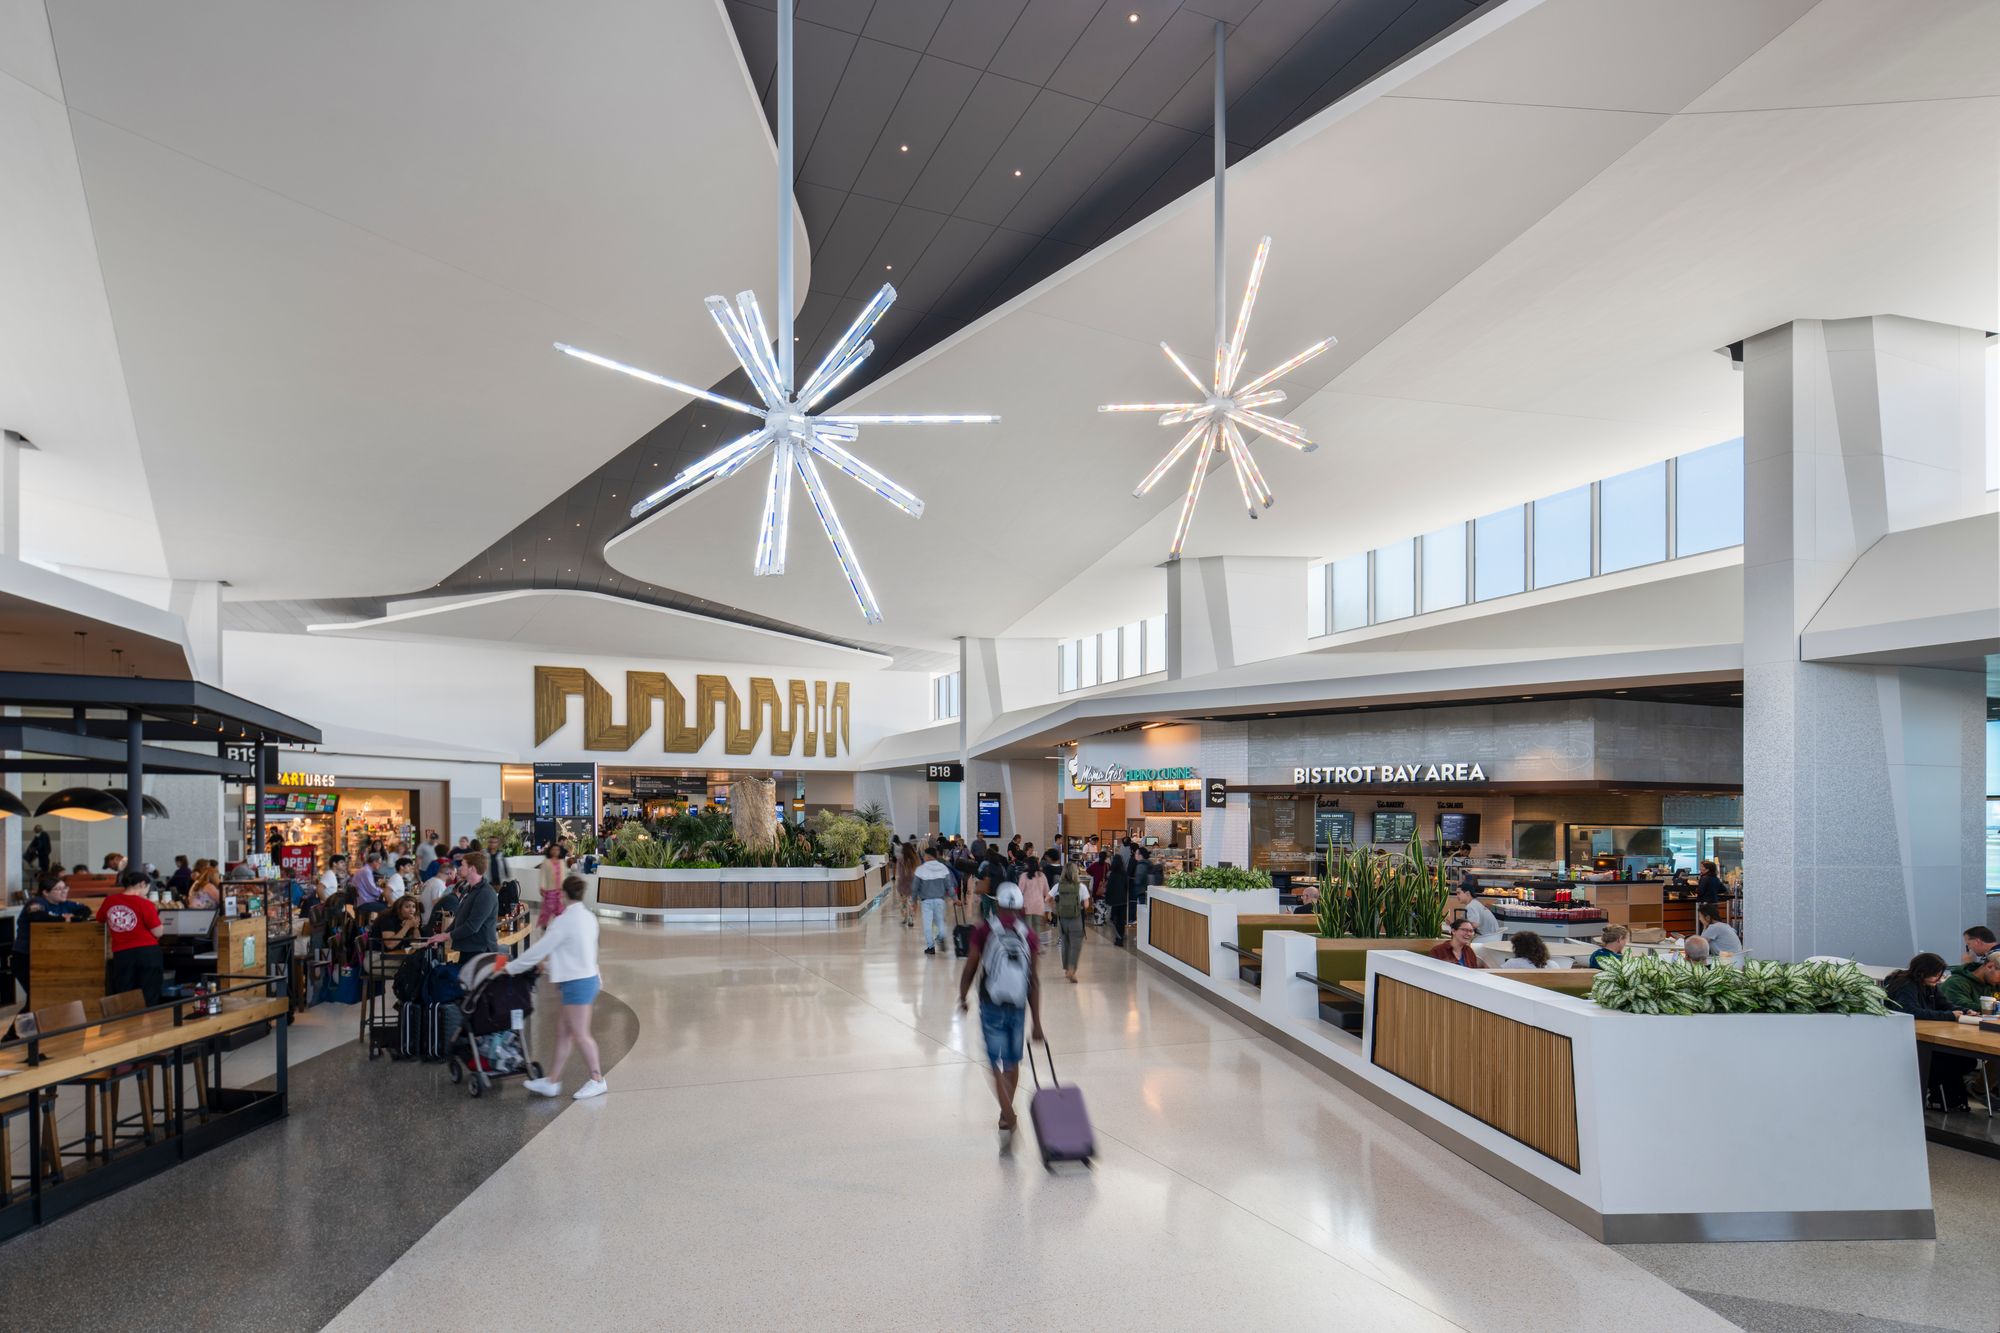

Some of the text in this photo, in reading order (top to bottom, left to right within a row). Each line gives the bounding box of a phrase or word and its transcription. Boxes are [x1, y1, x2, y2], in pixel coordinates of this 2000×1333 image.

[227, 747, 255, 762] B19
[929, 765, 951, 778] B18
[1125, 768, 1157, 781] FILIPINO
[1157, 766, 1191, 780] CUISINE
[1294, 762, 1486, 784] BISTROT BAY AREA
[282, 857, 311, 870] OPEN
